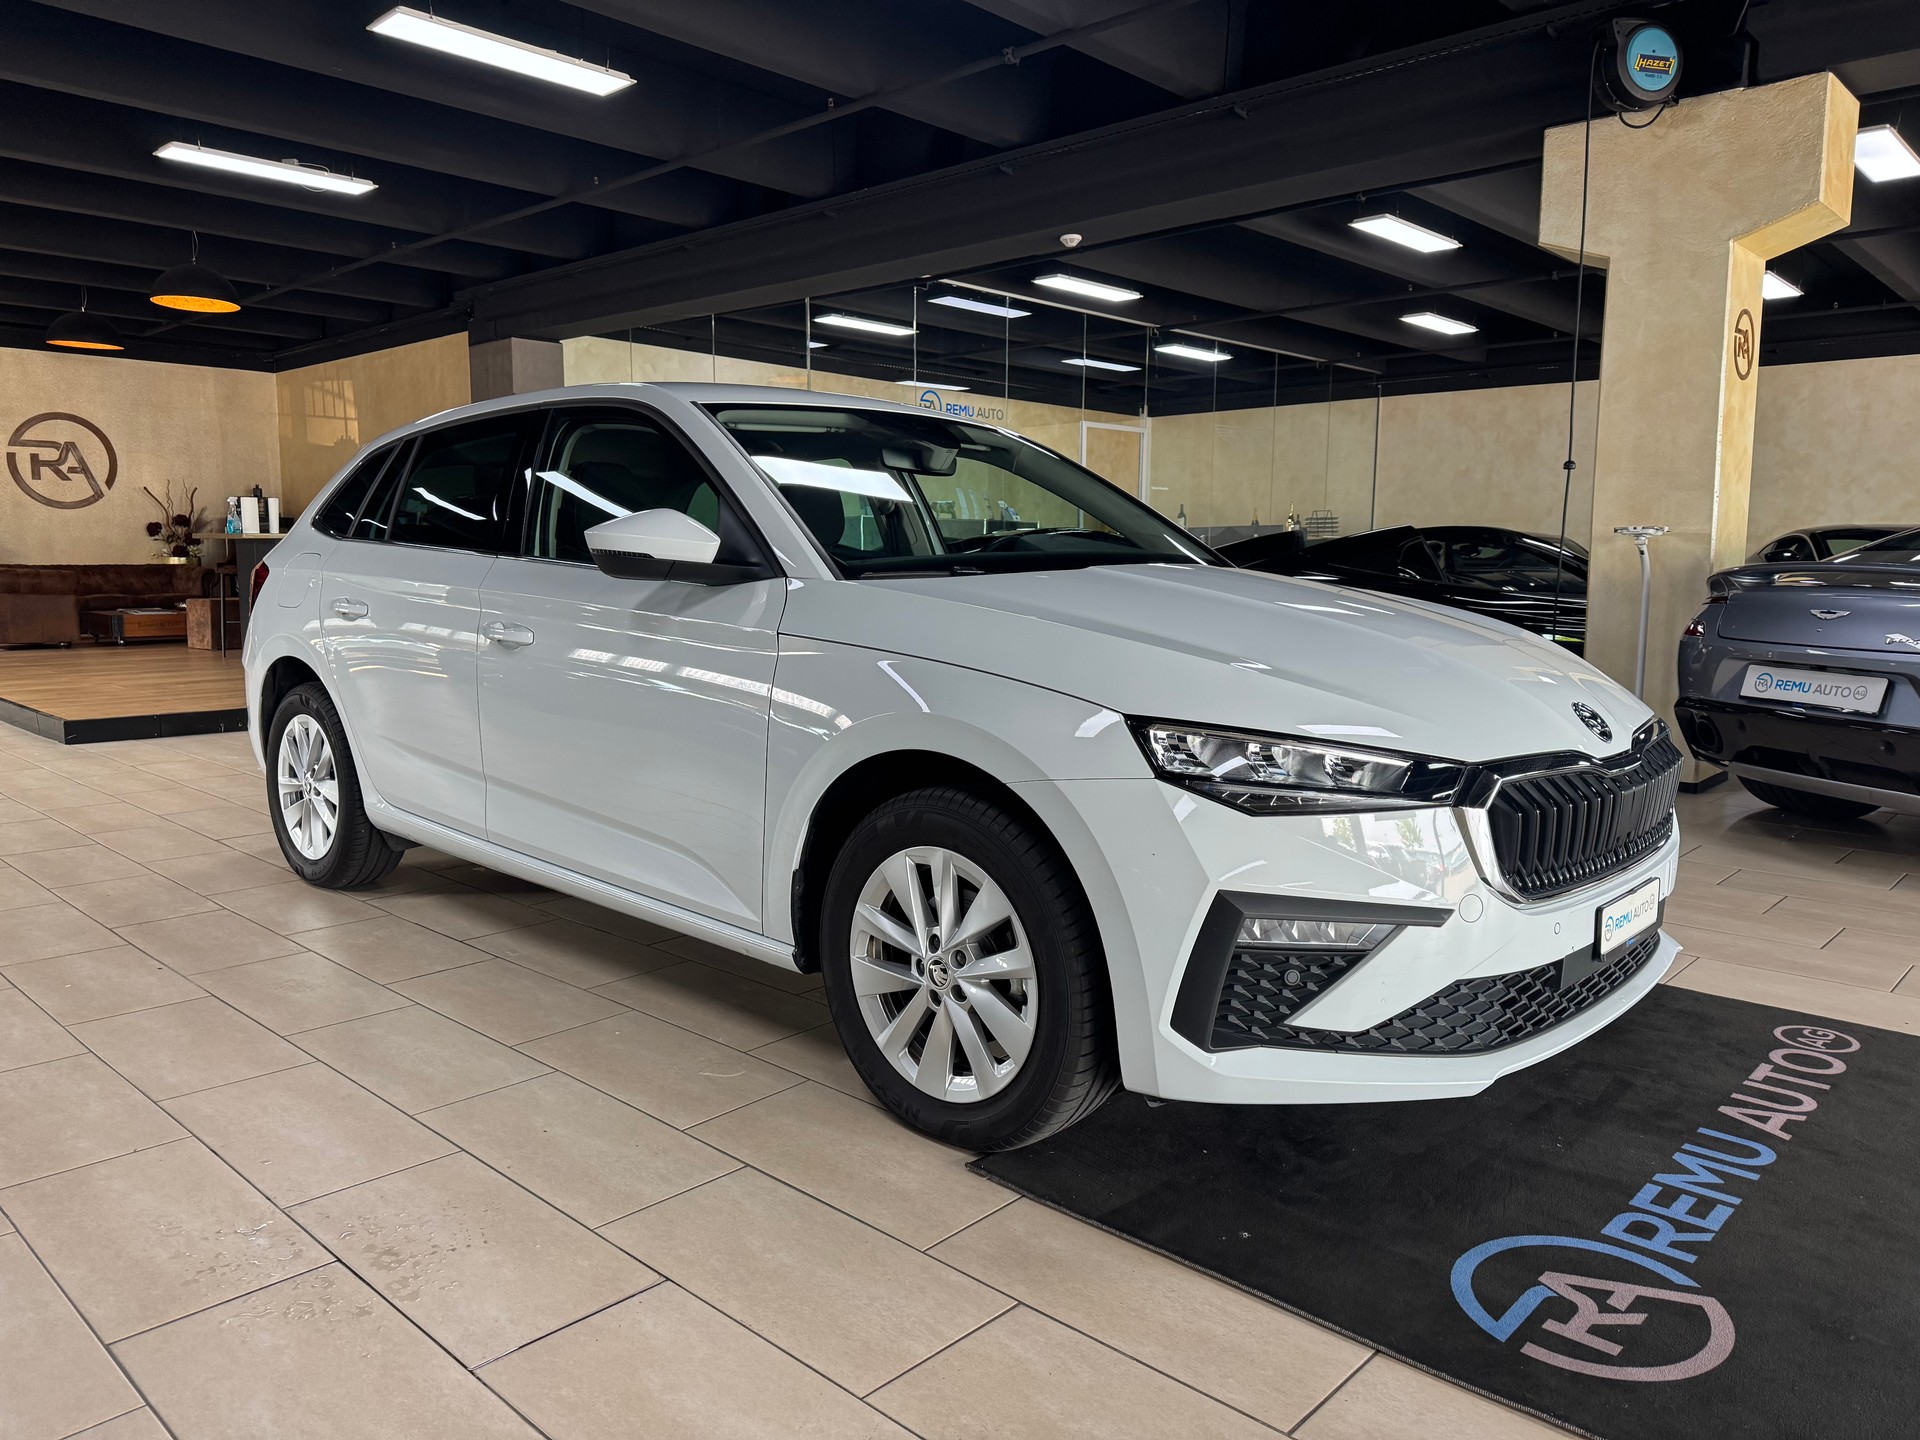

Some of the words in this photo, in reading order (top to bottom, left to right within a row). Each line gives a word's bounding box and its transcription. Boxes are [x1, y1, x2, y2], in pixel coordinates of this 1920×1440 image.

[1639, 57, 1671, 68] HAZET
[945, 403, 975, 418] REMU
[976, 408, 1004, 421] AUTO
[1774, 679, 1812, 694] REMU
[1812, 683, 1852, 698] AUTO
[1614, 909, 1633, 932] REMU
[1633, 900, 1649, 921] AUTO
[1600, 1127, 1777, 1264] REMU
[1717, 1047, 1848, 1141] AUTO
